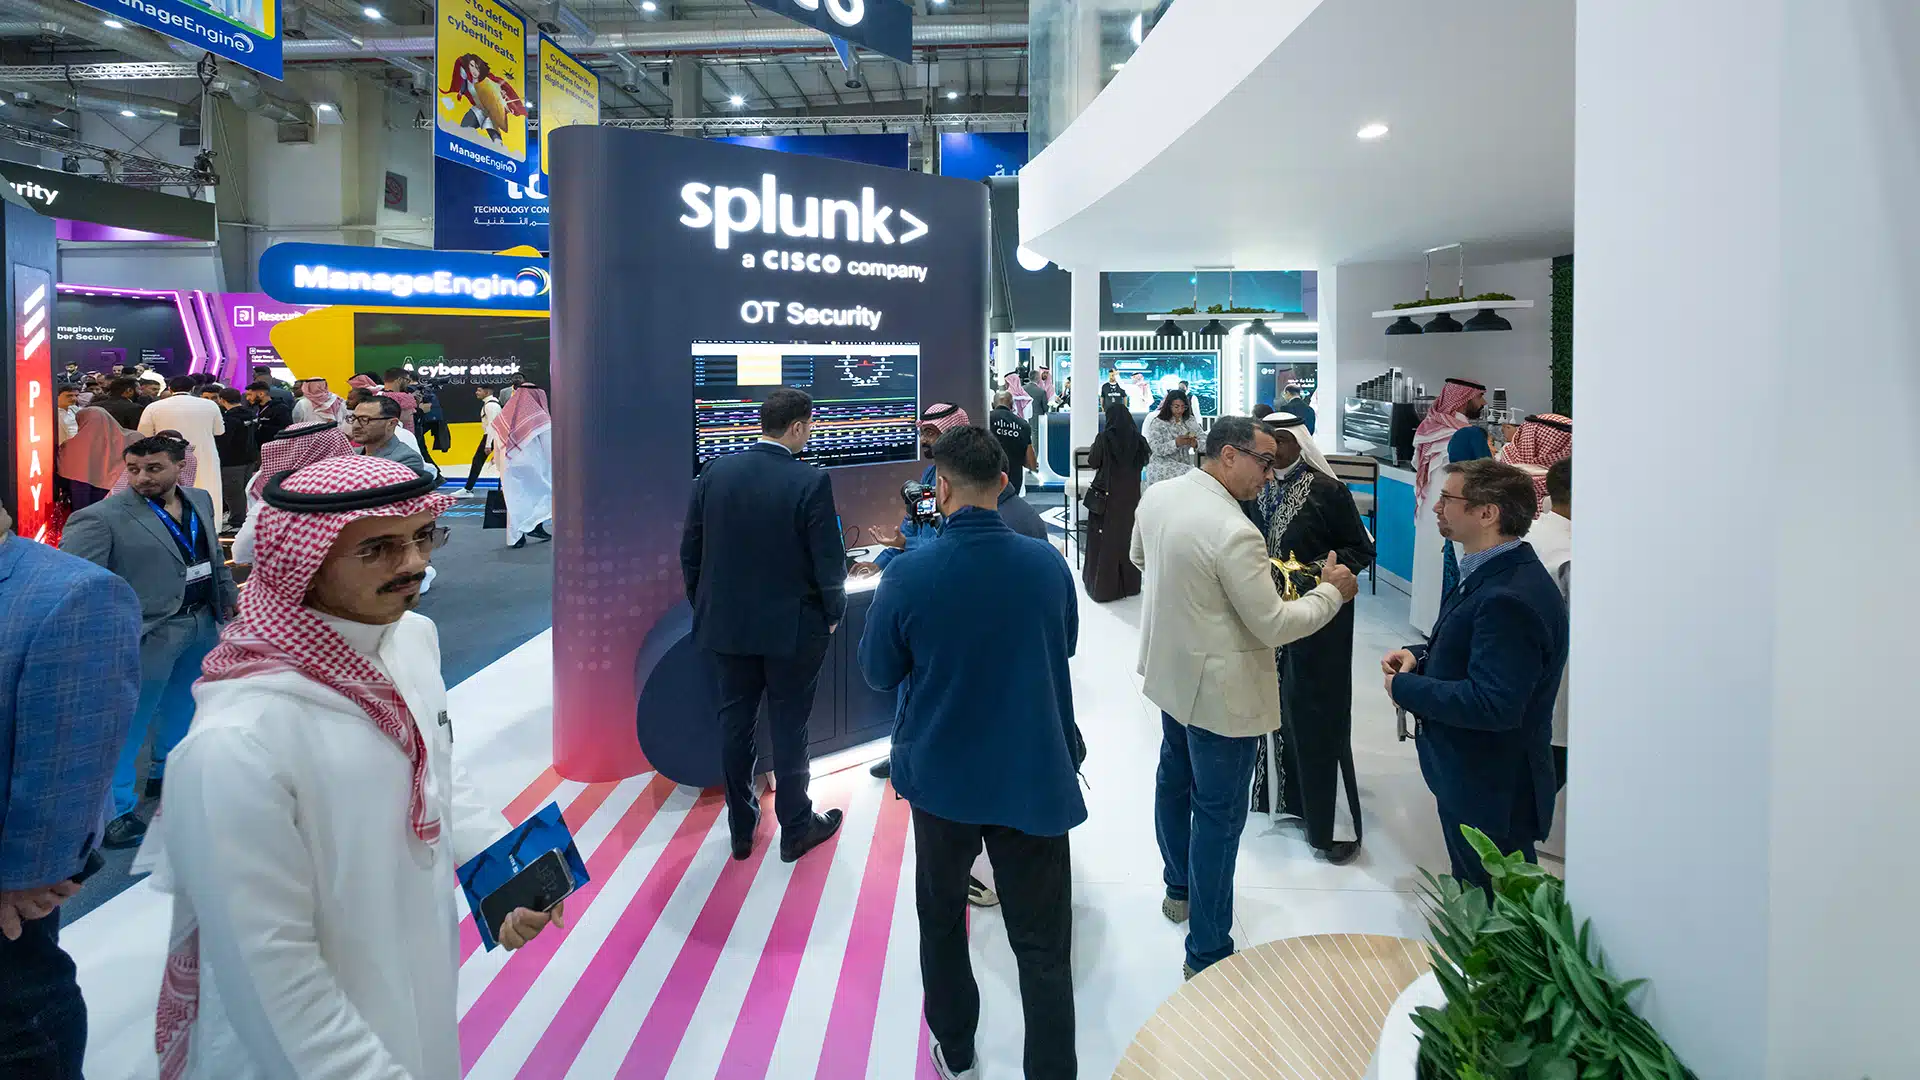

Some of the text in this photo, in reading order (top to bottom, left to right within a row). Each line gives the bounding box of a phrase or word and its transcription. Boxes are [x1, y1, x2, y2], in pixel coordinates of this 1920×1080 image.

[465, 10, 503, 40] against
[485, 8, 519, 37] defend
[447, 15, 518, 64] cyberthreats.
[449, 141, 514, 173] ManageEngine
[10, 181, 59, 206] rity
[473, 205, 529, 214] TECHNOLOGY
[294, 264, 538, 299] ManageEngine
[741, 252, 756, 269] a
[847, 260, 928, 283] company
[95, 325, 116, 334] Your
[740, 300, 883, 331] OT Security
[76, 333, 114, 342] Security
[418, 363, 468, 378] cyber
[470, 362, 521, 375] attack
[28, 380, 43, 512] PLAY
